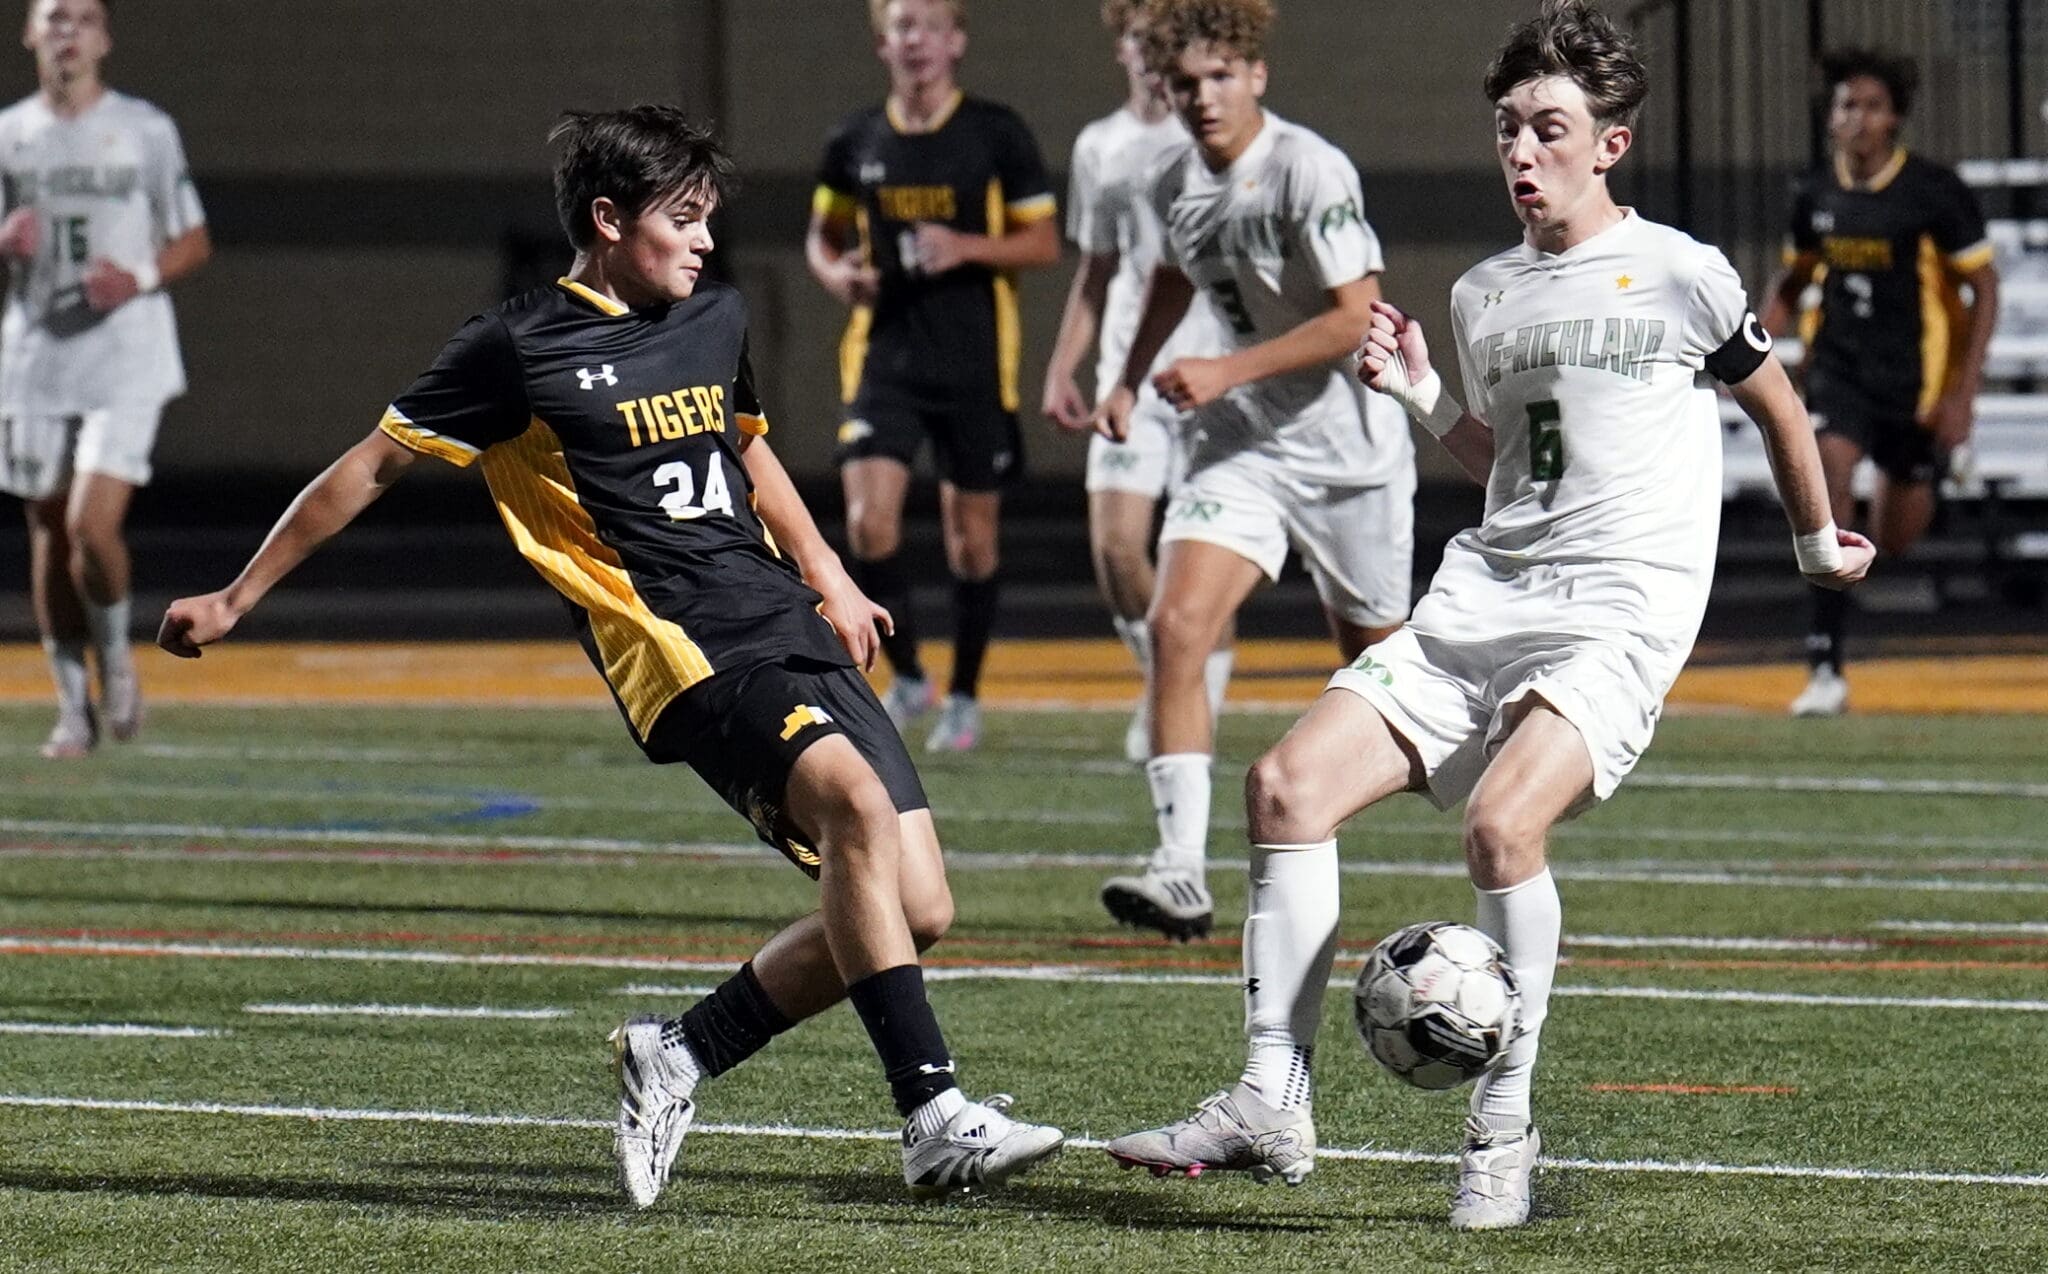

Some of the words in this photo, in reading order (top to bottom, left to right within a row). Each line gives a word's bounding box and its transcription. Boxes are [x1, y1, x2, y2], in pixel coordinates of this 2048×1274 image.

[1742, 311, 1773, 353] C
[615, 384, 726, 448] TIGERS
[1525, 399, 1564, 482] 6
[652, 450, 735, 518] 24
